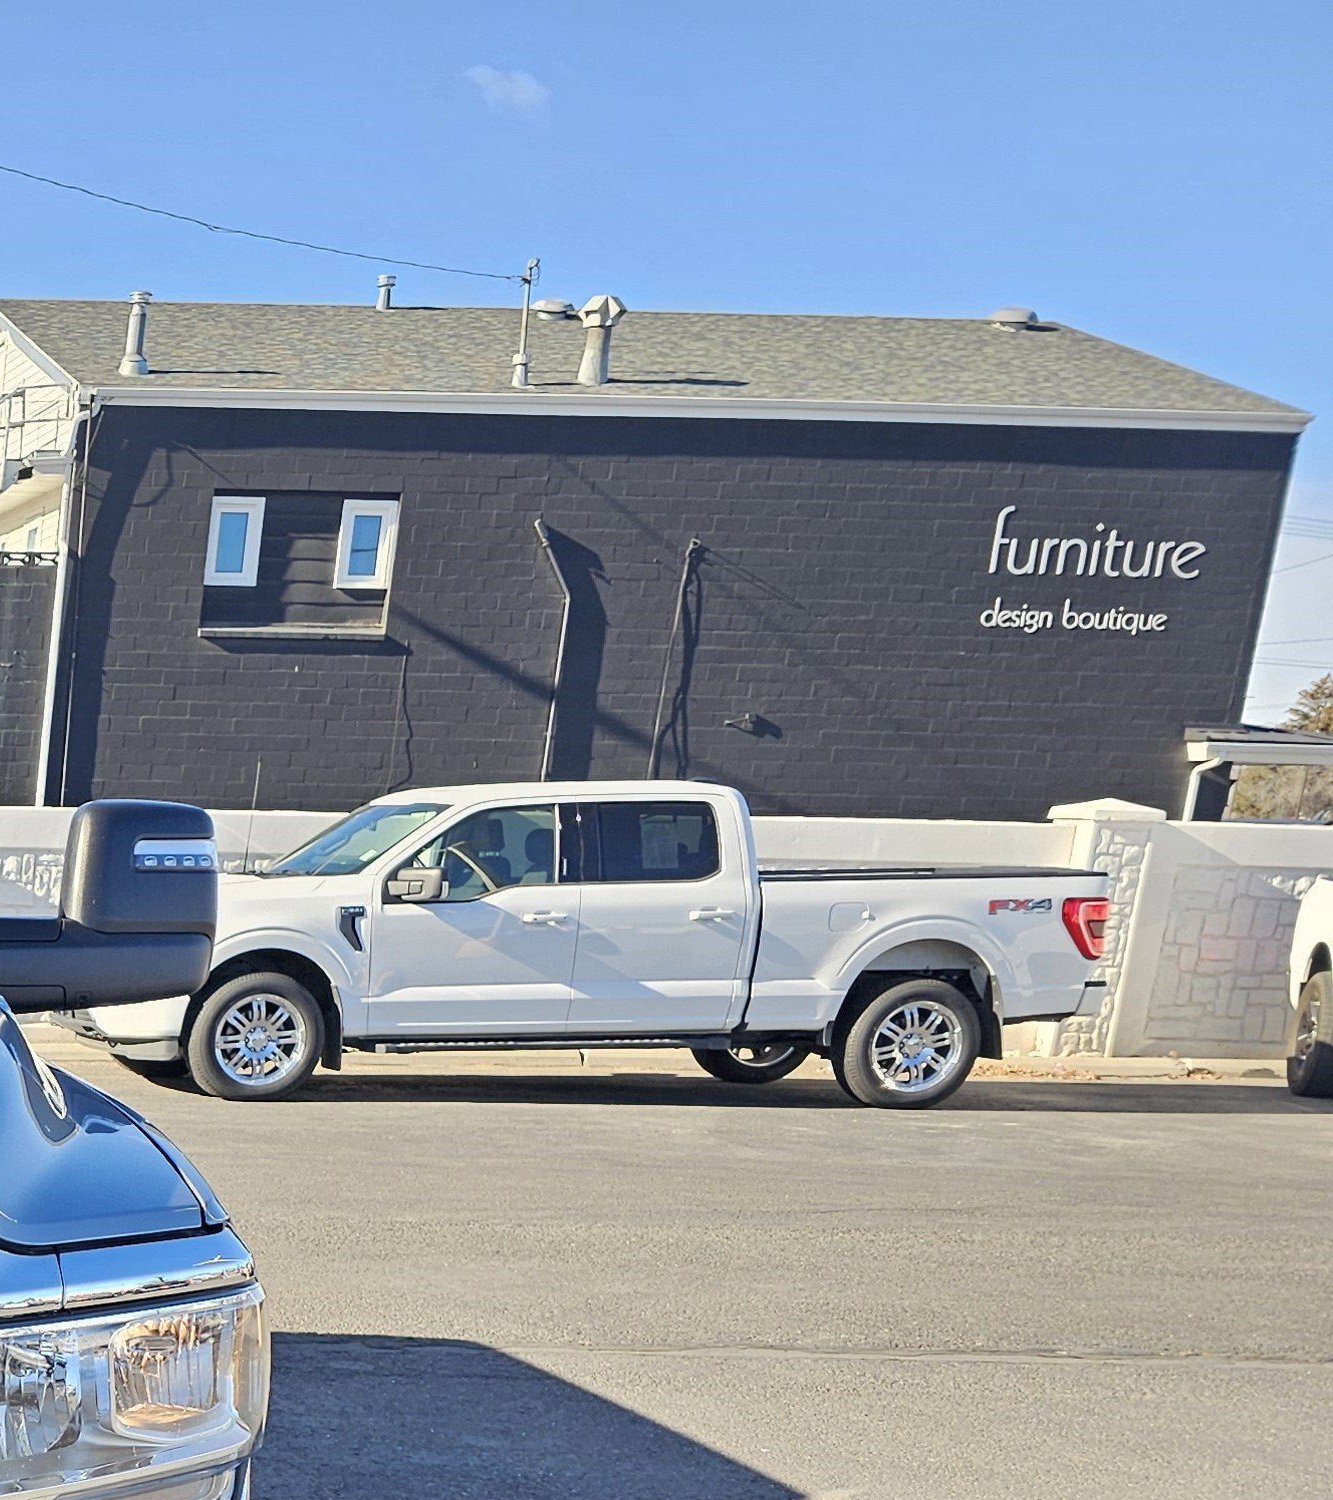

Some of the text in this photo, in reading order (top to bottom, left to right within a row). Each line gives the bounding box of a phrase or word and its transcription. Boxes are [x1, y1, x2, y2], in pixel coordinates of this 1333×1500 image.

[987, 504, 1207, 580] furniture
[979, 596, 1169, 637] design boutique
[988, 898, 1053, 915] FX4
